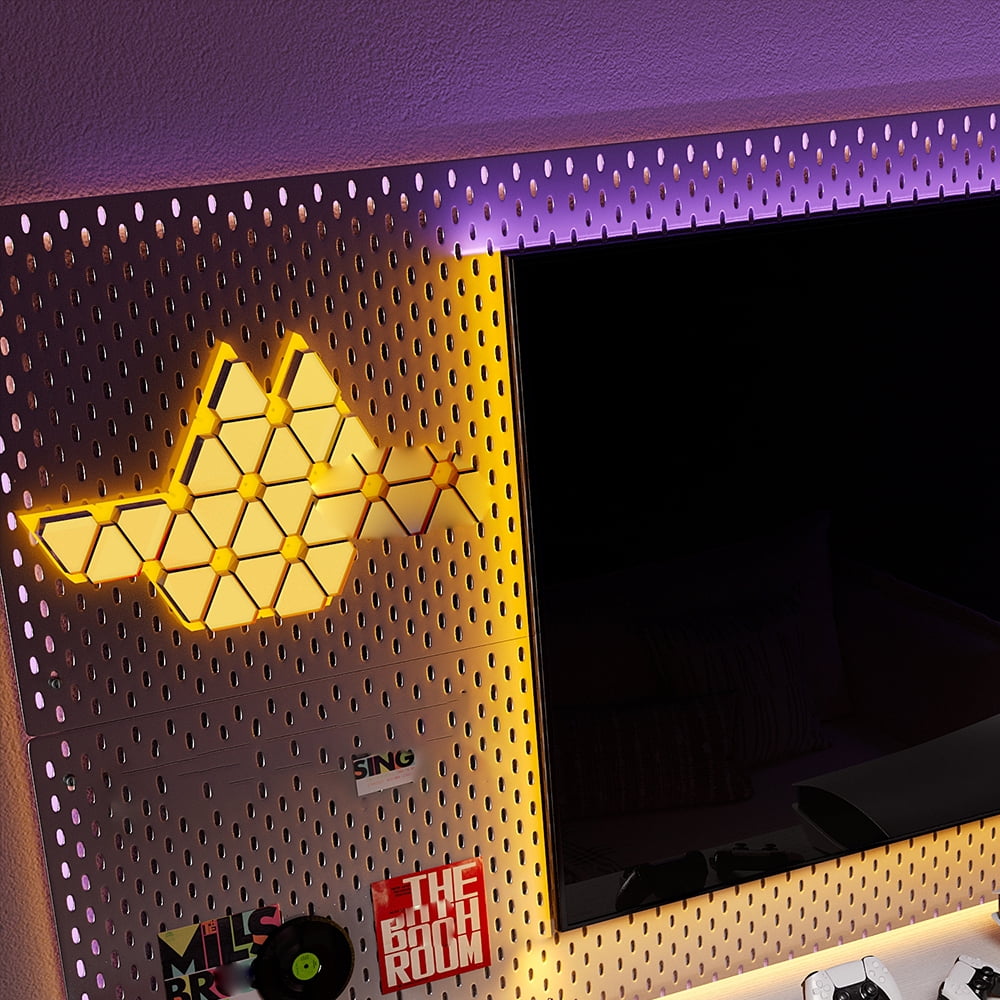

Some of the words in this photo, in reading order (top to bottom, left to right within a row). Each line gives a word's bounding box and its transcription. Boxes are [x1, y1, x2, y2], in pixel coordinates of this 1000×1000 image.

[353, 749, 415, 779] SING
[402, 862, 478, 910] THE
[384, 930, 484, 988] ROOM
